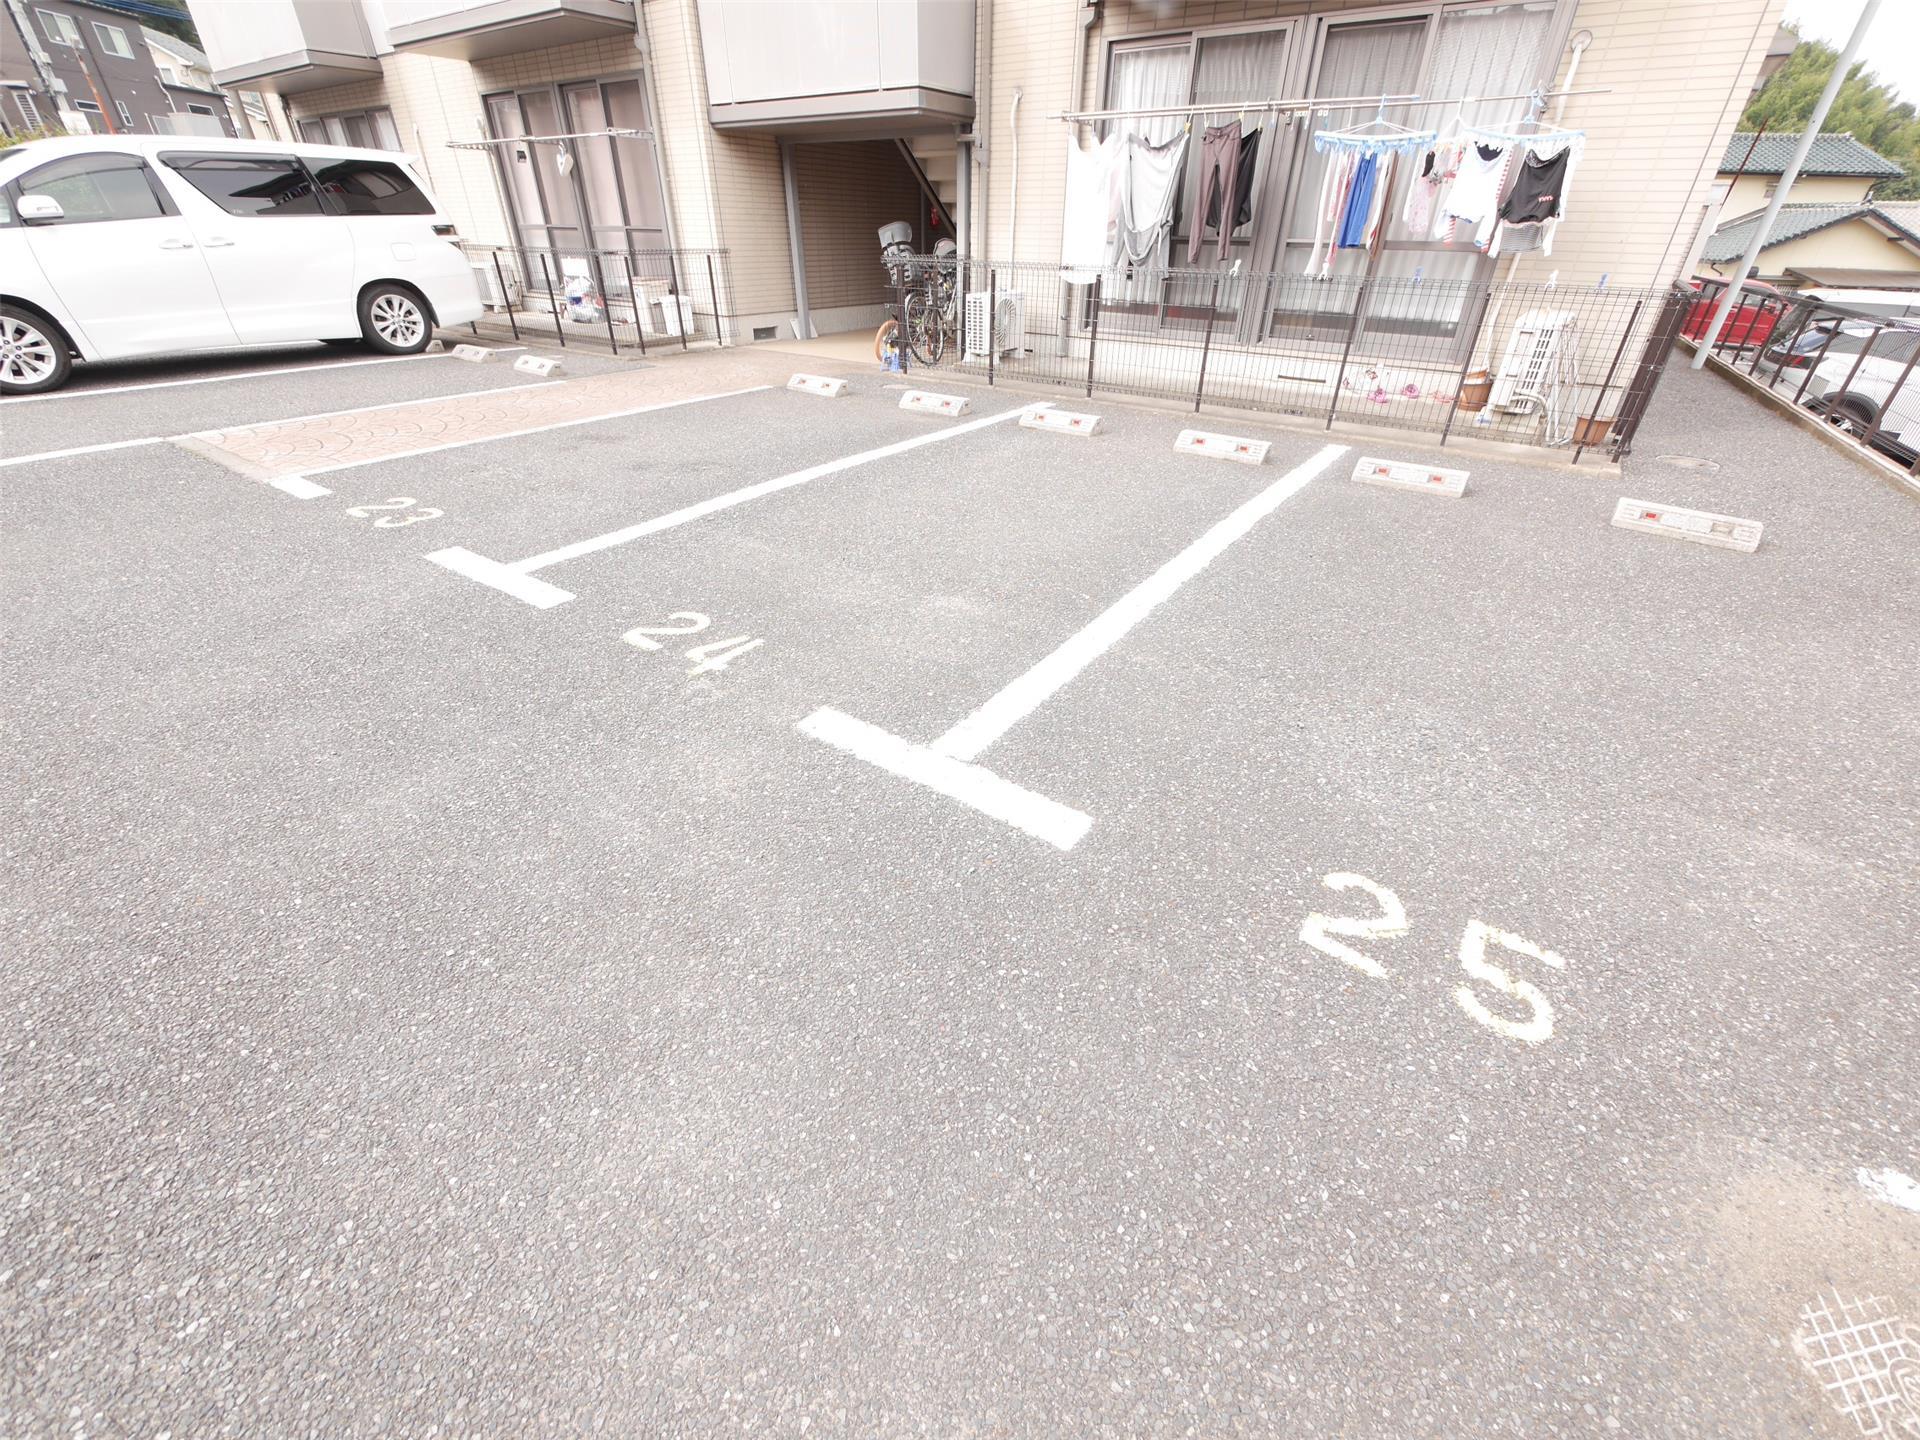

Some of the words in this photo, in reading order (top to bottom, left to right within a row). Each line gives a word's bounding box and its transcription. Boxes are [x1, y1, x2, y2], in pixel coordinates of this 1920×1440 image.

[346, 497, 444, 527] 23
[623, 611, 766, 678] 24
[1300, 871, 1567, 1043] 25
